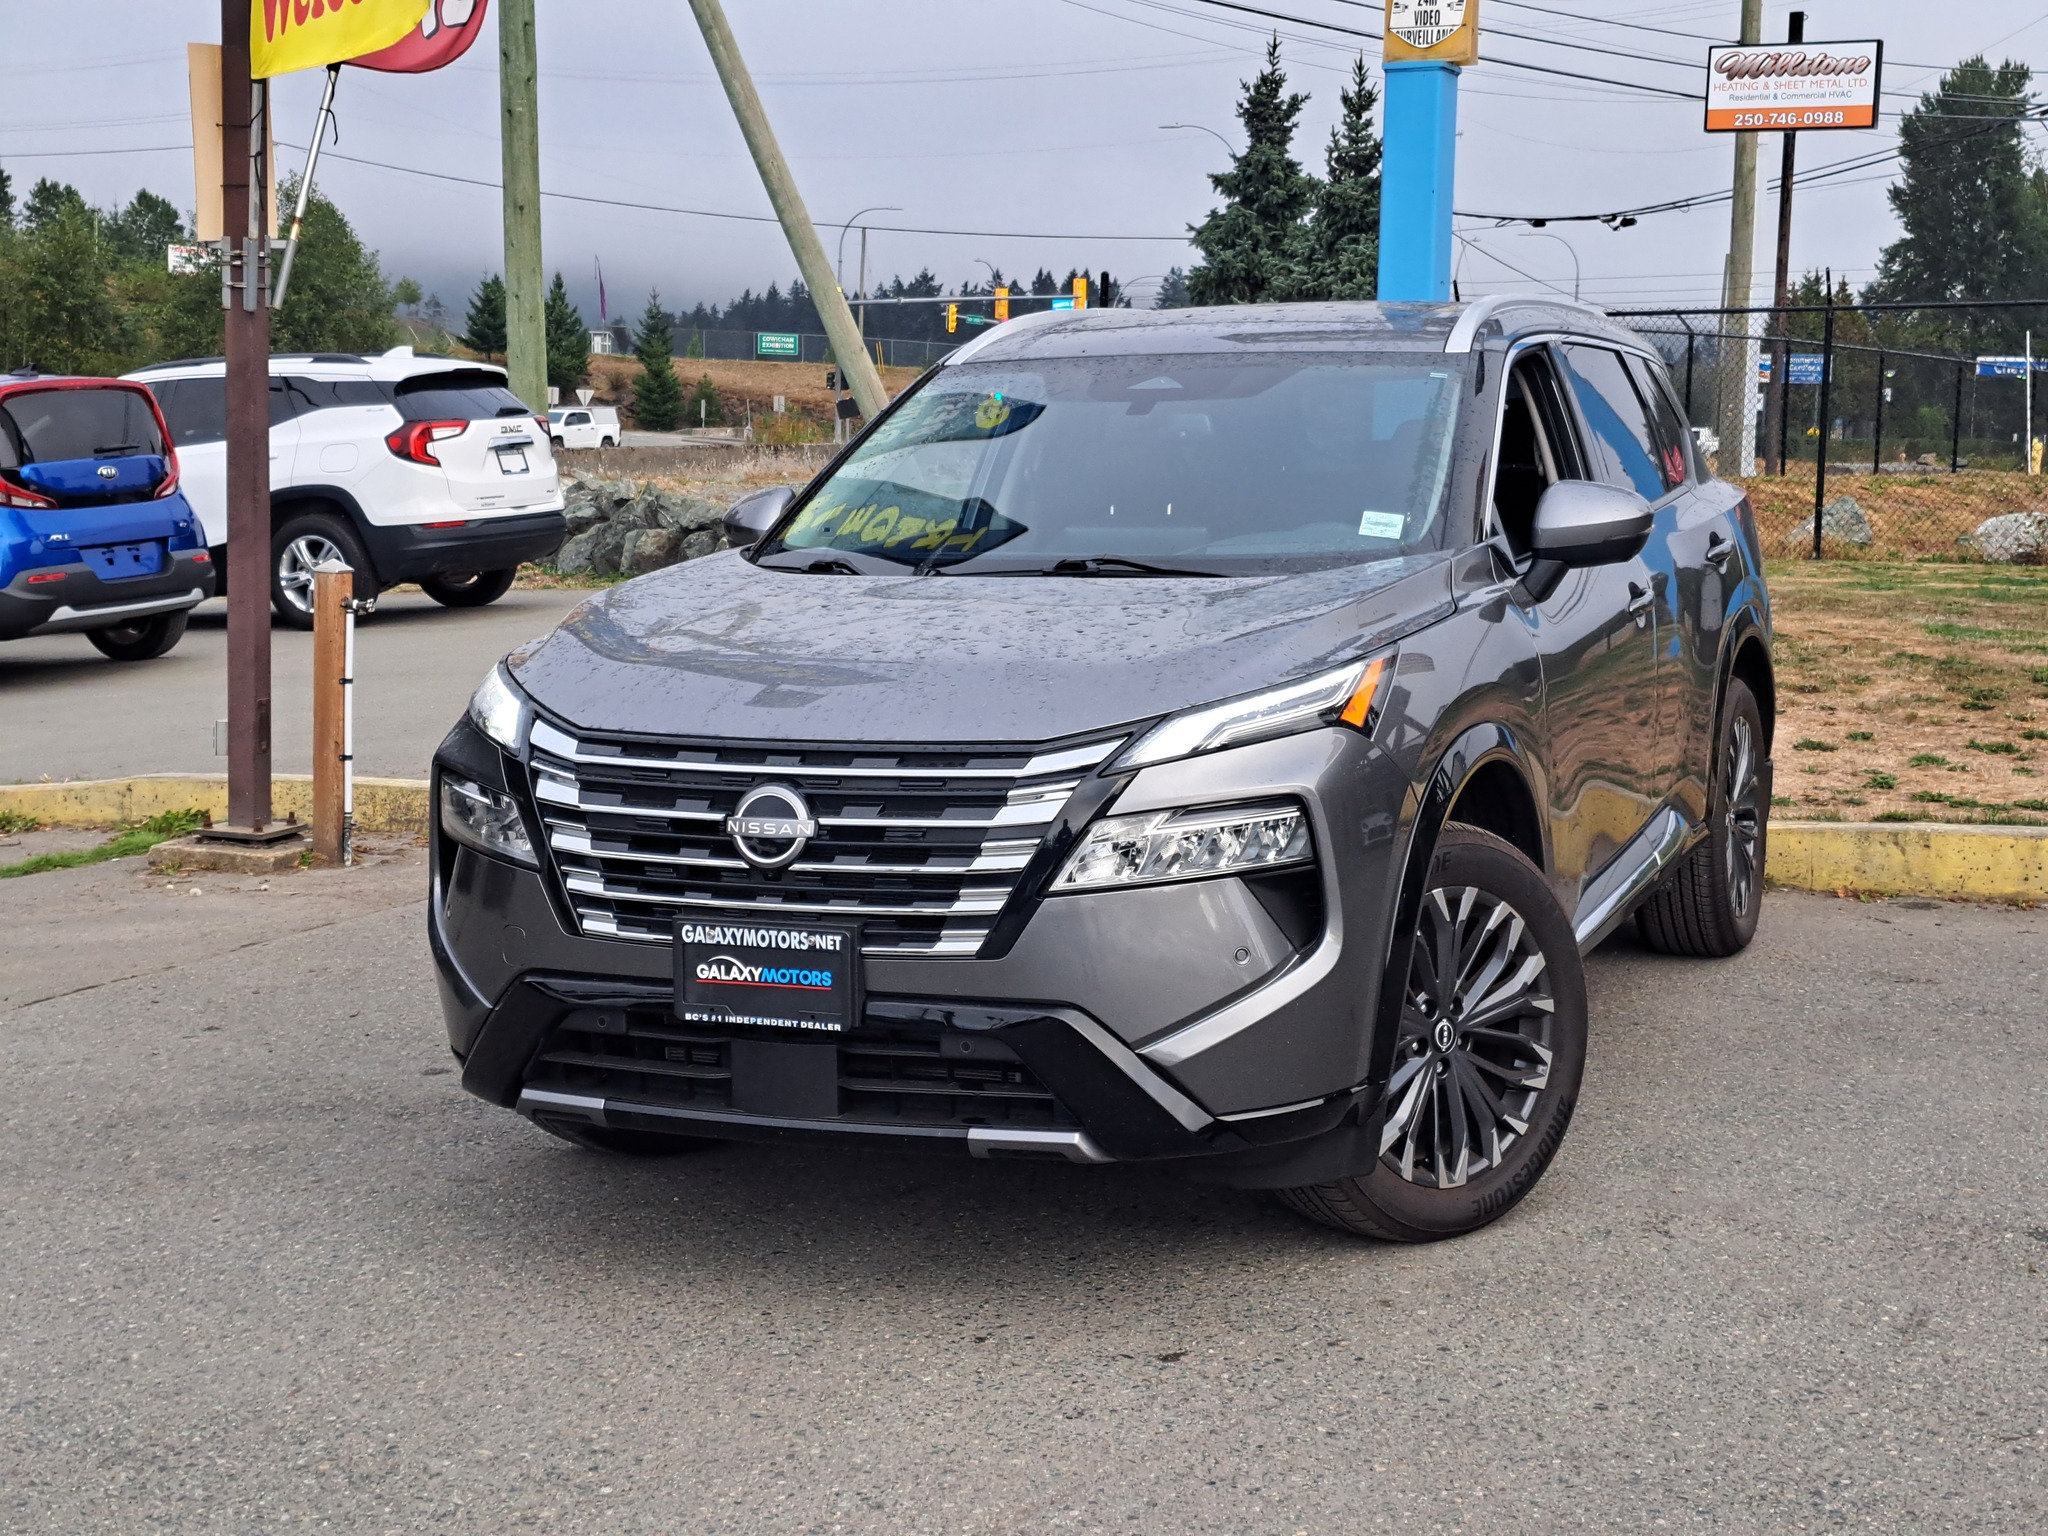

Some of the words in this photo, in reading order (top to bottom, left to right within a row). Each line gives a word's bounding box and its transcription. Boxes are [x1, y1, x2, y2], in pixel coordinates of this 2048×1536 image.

[1414, 10, 1440, 26] VIDEO
[1714, 52, 1871, 80] Millstone
[1714, 81, 1759, 92] HEATING
[1763, 82, 1770, 90] &
[1774, 80, 1806, 90] SHEET
[1810, 79, 1844, 89] METAL
[1848, 78, 1870, 88] LTD.
[1729, 93, 1771, 101] Residential
[1781, 91, 1827, 100] Commercial
[1734, 111, 1844, 126] 250-746-0988
[501, 425, 523, 434] GMC
[727, 820, 811, 835] NISSAN
[681, 924, 842, 951] GALAXYMOTORSNET
[685, 1013, 708, 1021] BC'S
[725, 1015, 799, 1028] INDEPENDENT
[800, 1021, 841, 1031] DEALER
